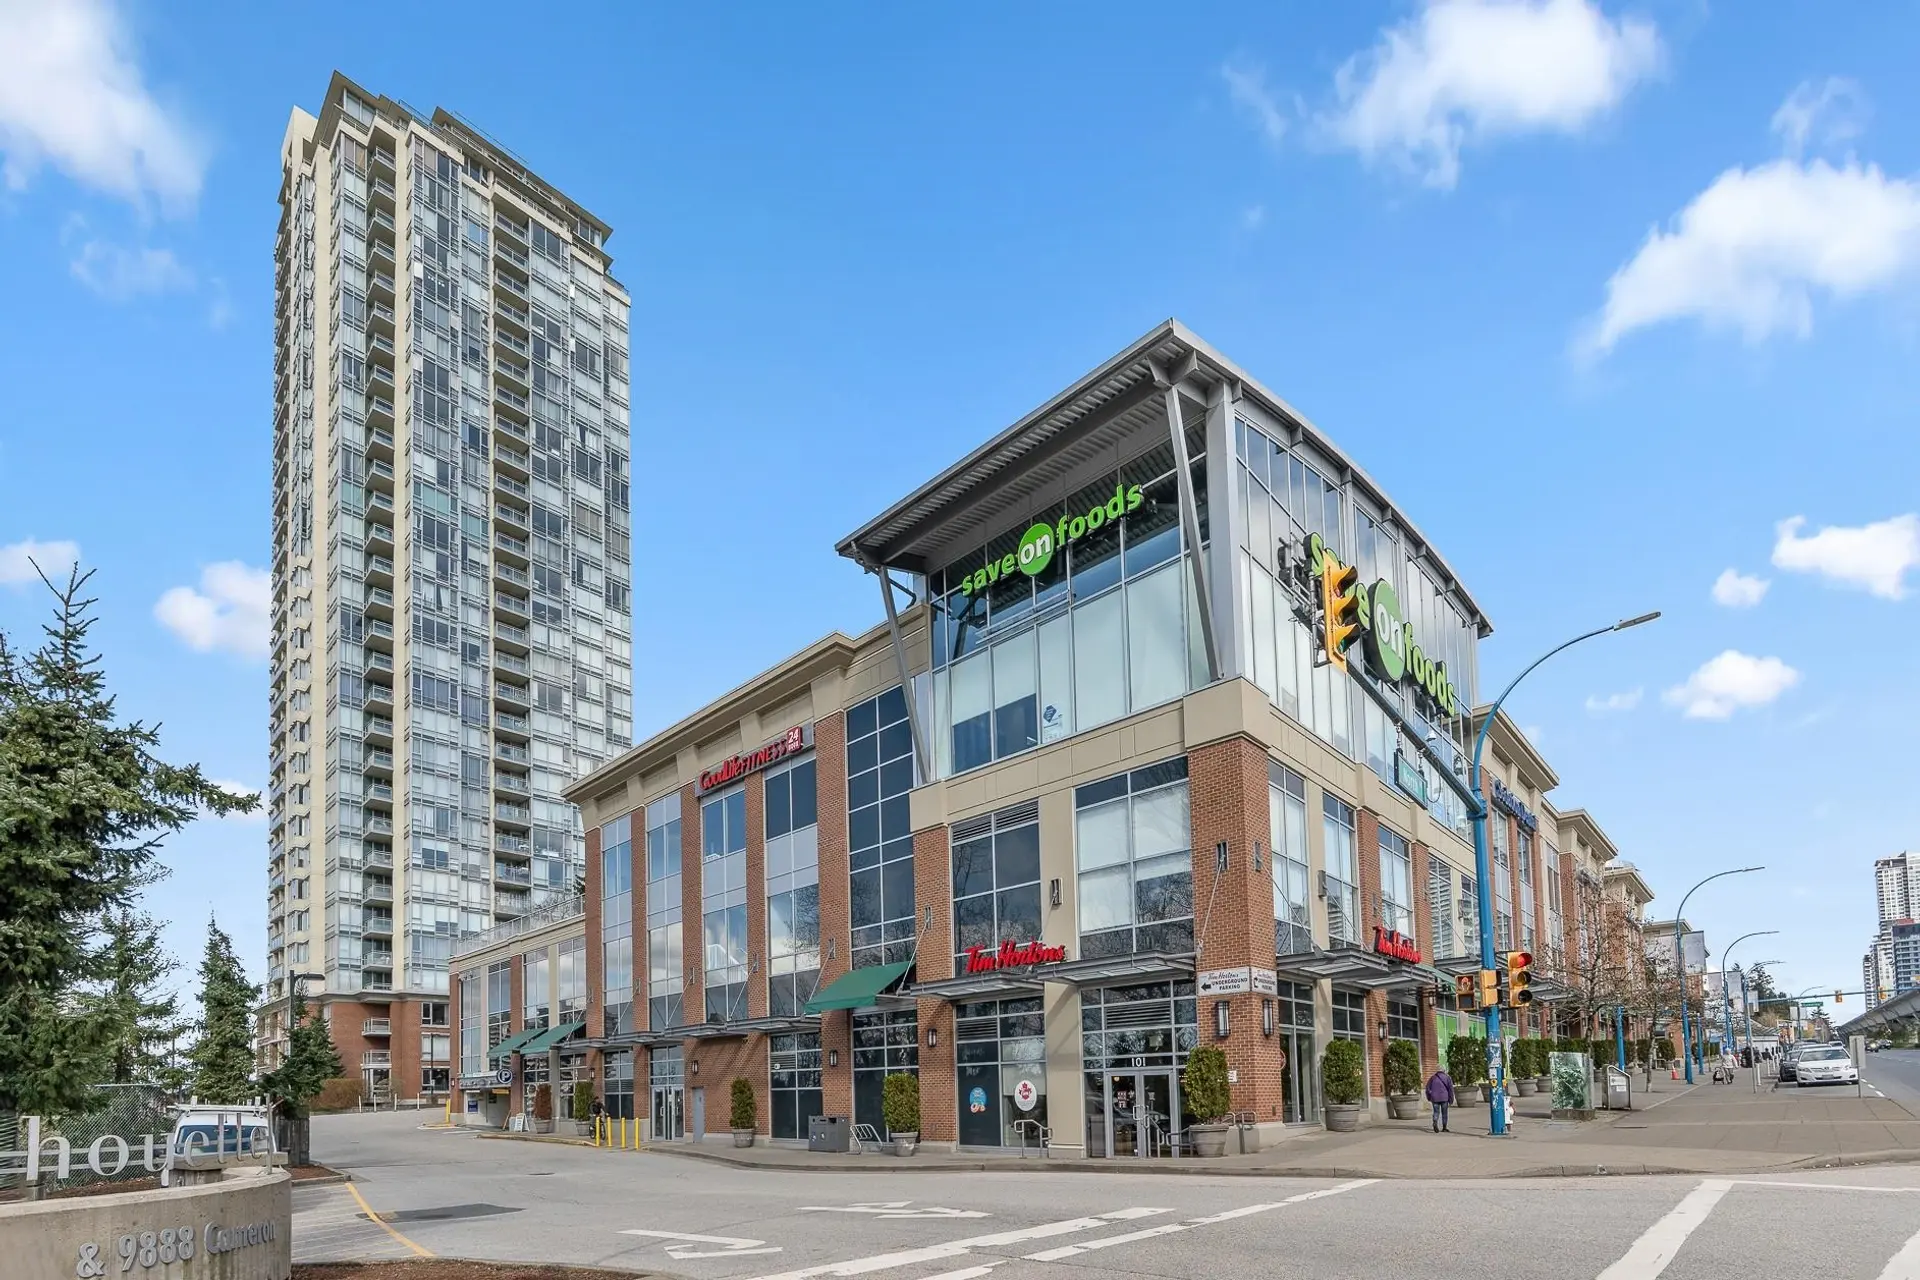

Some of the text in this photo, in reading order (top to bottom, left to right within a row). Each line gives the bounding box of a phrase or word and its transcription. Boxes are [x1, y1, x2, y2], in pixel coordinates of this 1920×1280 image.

[962, 482, 1144, 597] save on foods
[1376, 602, 1403, 660] on
[1403, 621, 1455, 717] foods
[788, 728, 799, 744] 24
[965, 937, 1065, 973] Tim Hortons
[1211, 977, 1248, 986] UNDERGROUND
[1131, 1057, 1146, 1067] 101
[76, 1242, 104, 1278] &
[118, 1225, 195, 1272] 9888
